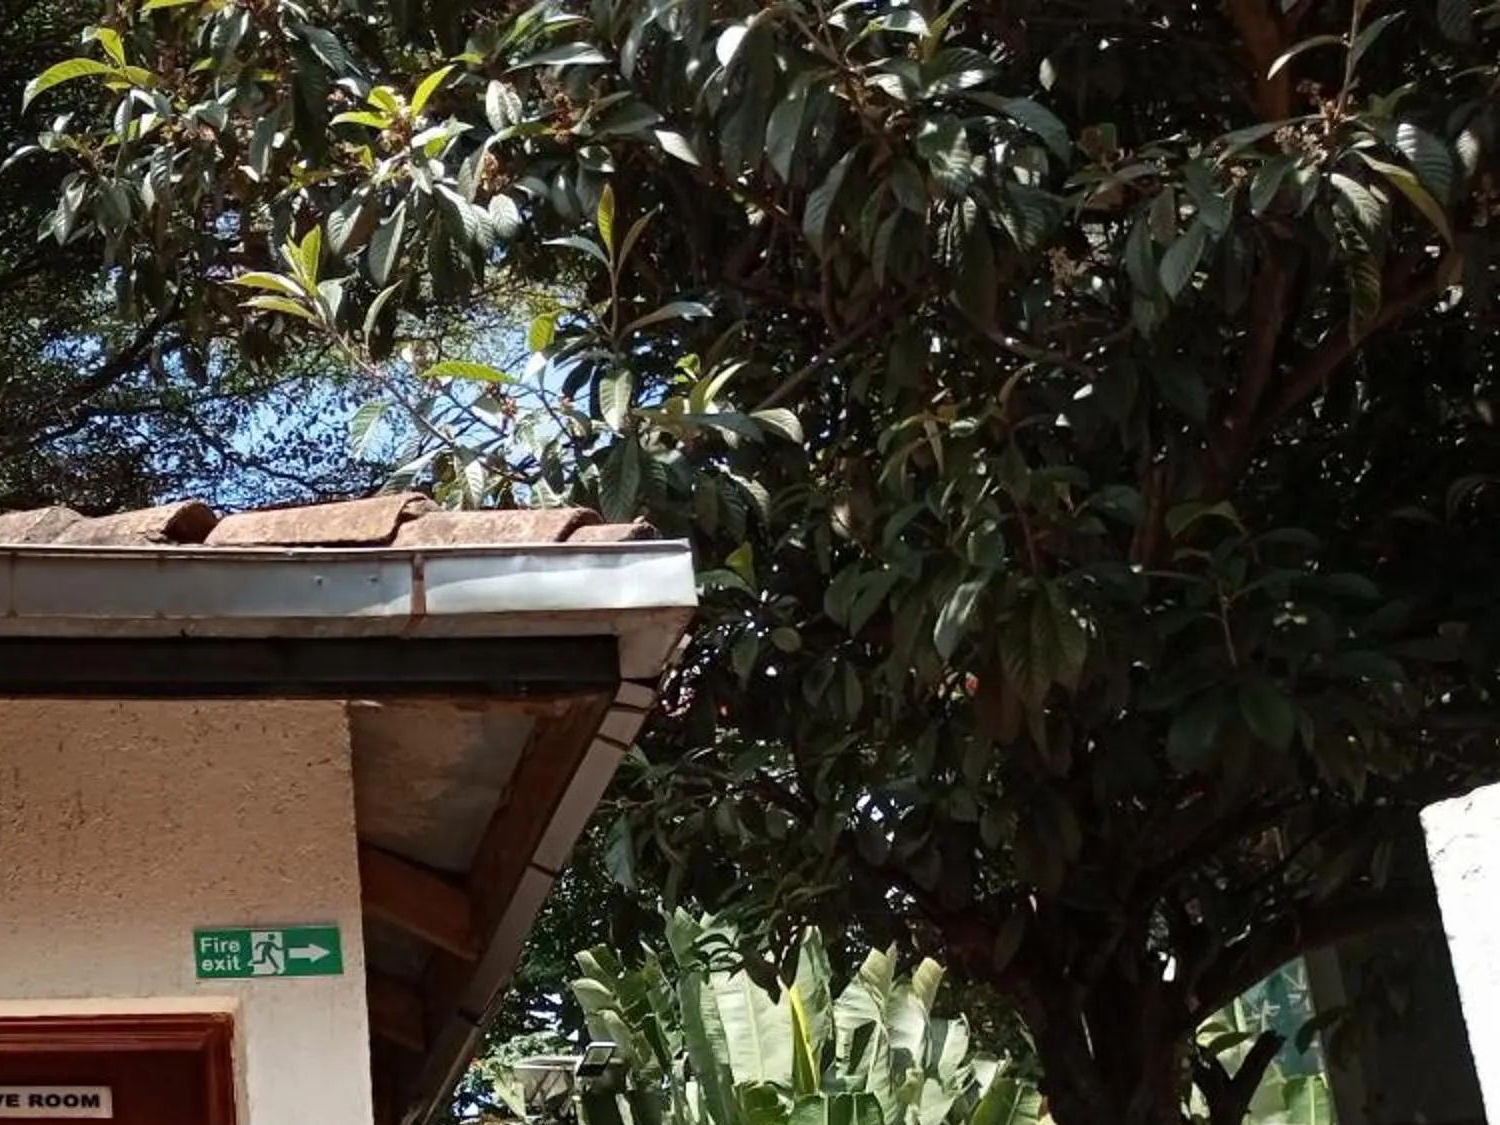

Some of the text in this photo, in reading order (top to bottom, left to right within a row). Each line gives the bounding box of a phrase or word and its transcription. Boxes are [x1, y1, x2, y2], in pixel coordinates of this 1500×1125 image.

[200, 937, 240, 953] Fire
[201, 955, 241, 971] exit
[29, 1093, 99, 1108] ROOM
